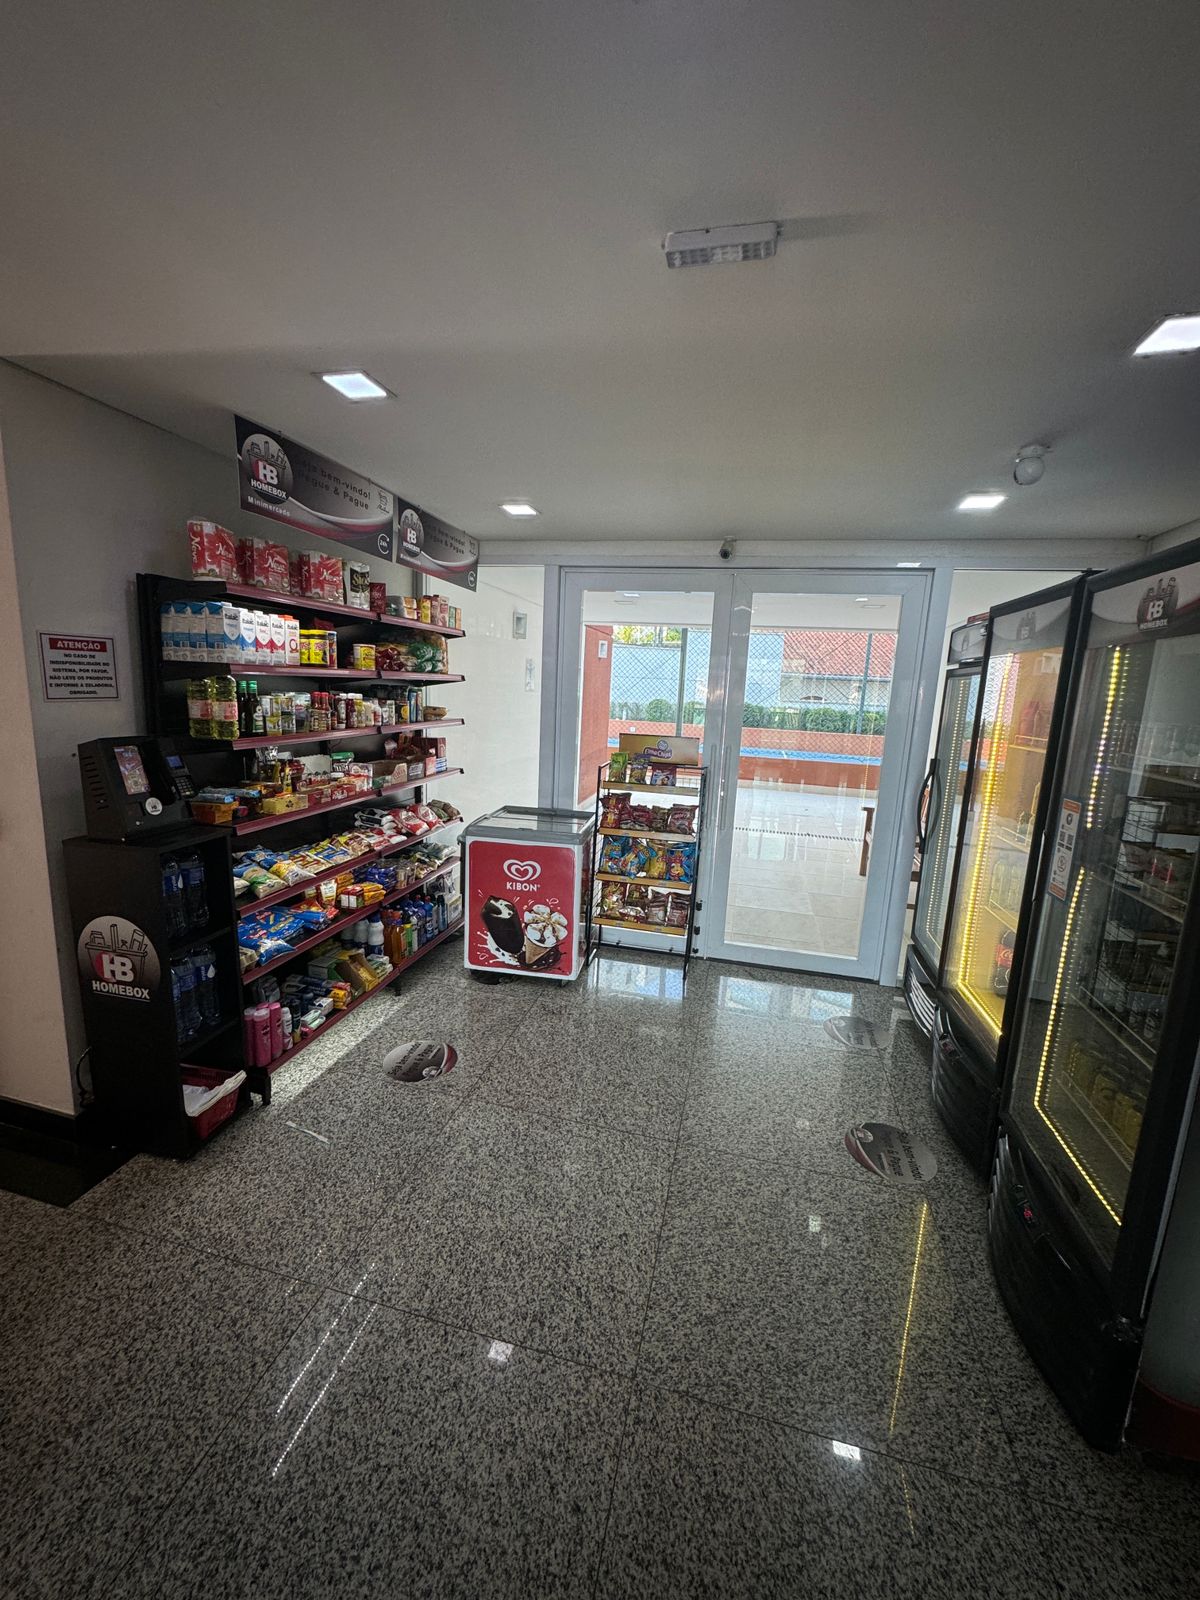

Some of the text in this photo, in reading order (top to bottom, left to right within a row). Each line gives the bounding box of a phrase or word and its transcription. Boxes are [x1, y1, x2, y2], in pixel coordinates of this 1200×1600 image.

[250, 478, 287, 500] HOMEBOX
[247, 495, 291, 517] Minimercado
[56, 640, 101, 651] ATENÇÃO
[506, 881, 537, 892] KIBON
[101, 953, 135, 982] HB
[91, 979, 150, 1000] HOMEBOX
